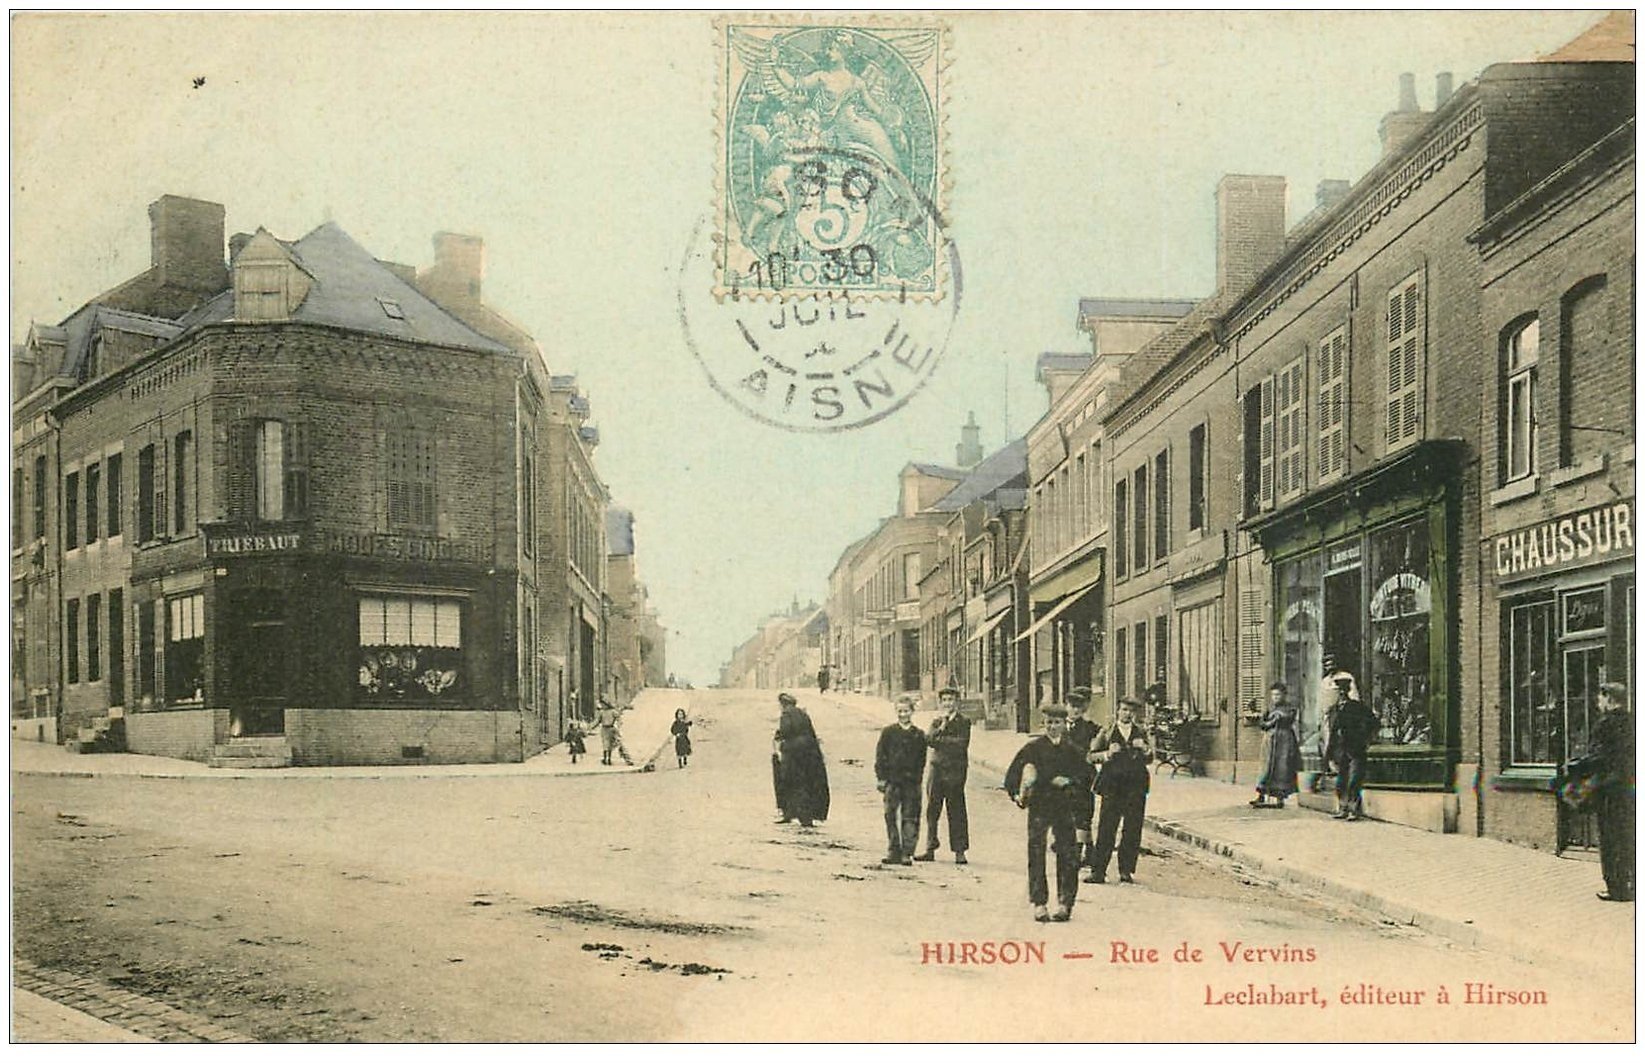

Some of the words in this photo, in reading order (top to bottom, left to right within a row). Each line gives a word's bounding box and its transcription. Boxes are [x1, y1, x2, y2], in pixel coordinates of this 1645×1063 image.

[820, 243, 876, 281] 30
[741, 330, 933, 422] AISNE
[1496, 503, 1634, 576] CHAUSSUR
